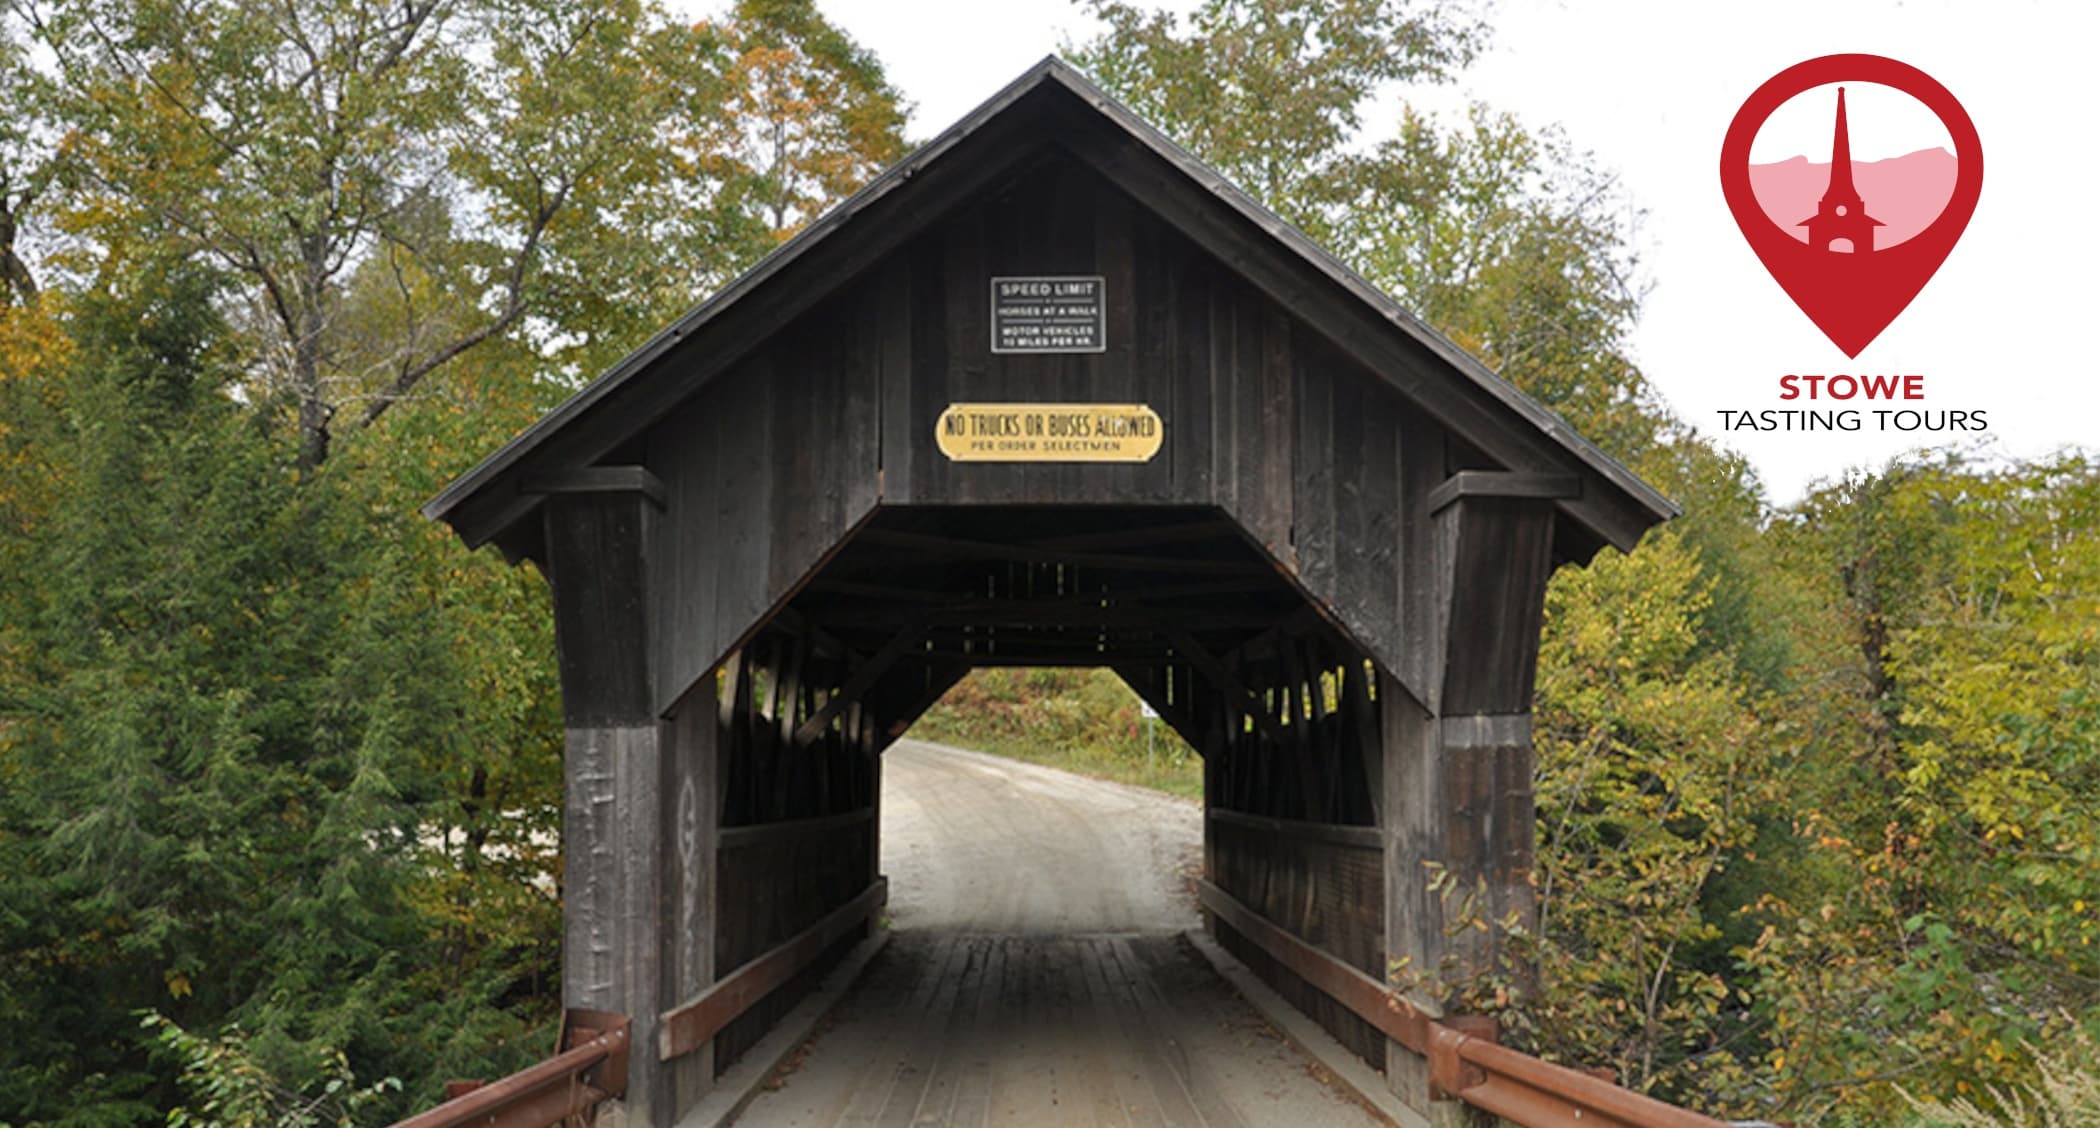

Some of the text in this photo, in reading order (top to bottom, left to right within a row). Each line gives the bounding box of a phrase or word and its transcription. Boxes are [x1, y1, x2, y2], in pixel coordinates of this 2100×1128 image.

[1001, 283, 1093, 296] SPEED LIMIT
[1043, 307, 1056, 316] AT
[1058, 307, 1065, 316] A
[1068, 307, 1097, 316] WALK
[1002, 326, 1094, 336] MOTOR VEHICLES
[1018, 337, 1049, 346] MILES
[1051, 337, 1073, 346] PER
[945, 414, 1154, 437] NO TRUCKS OR BUSES ALLOWED
[971, 441, 1120, 451] PER ORDER SELECTMEN
